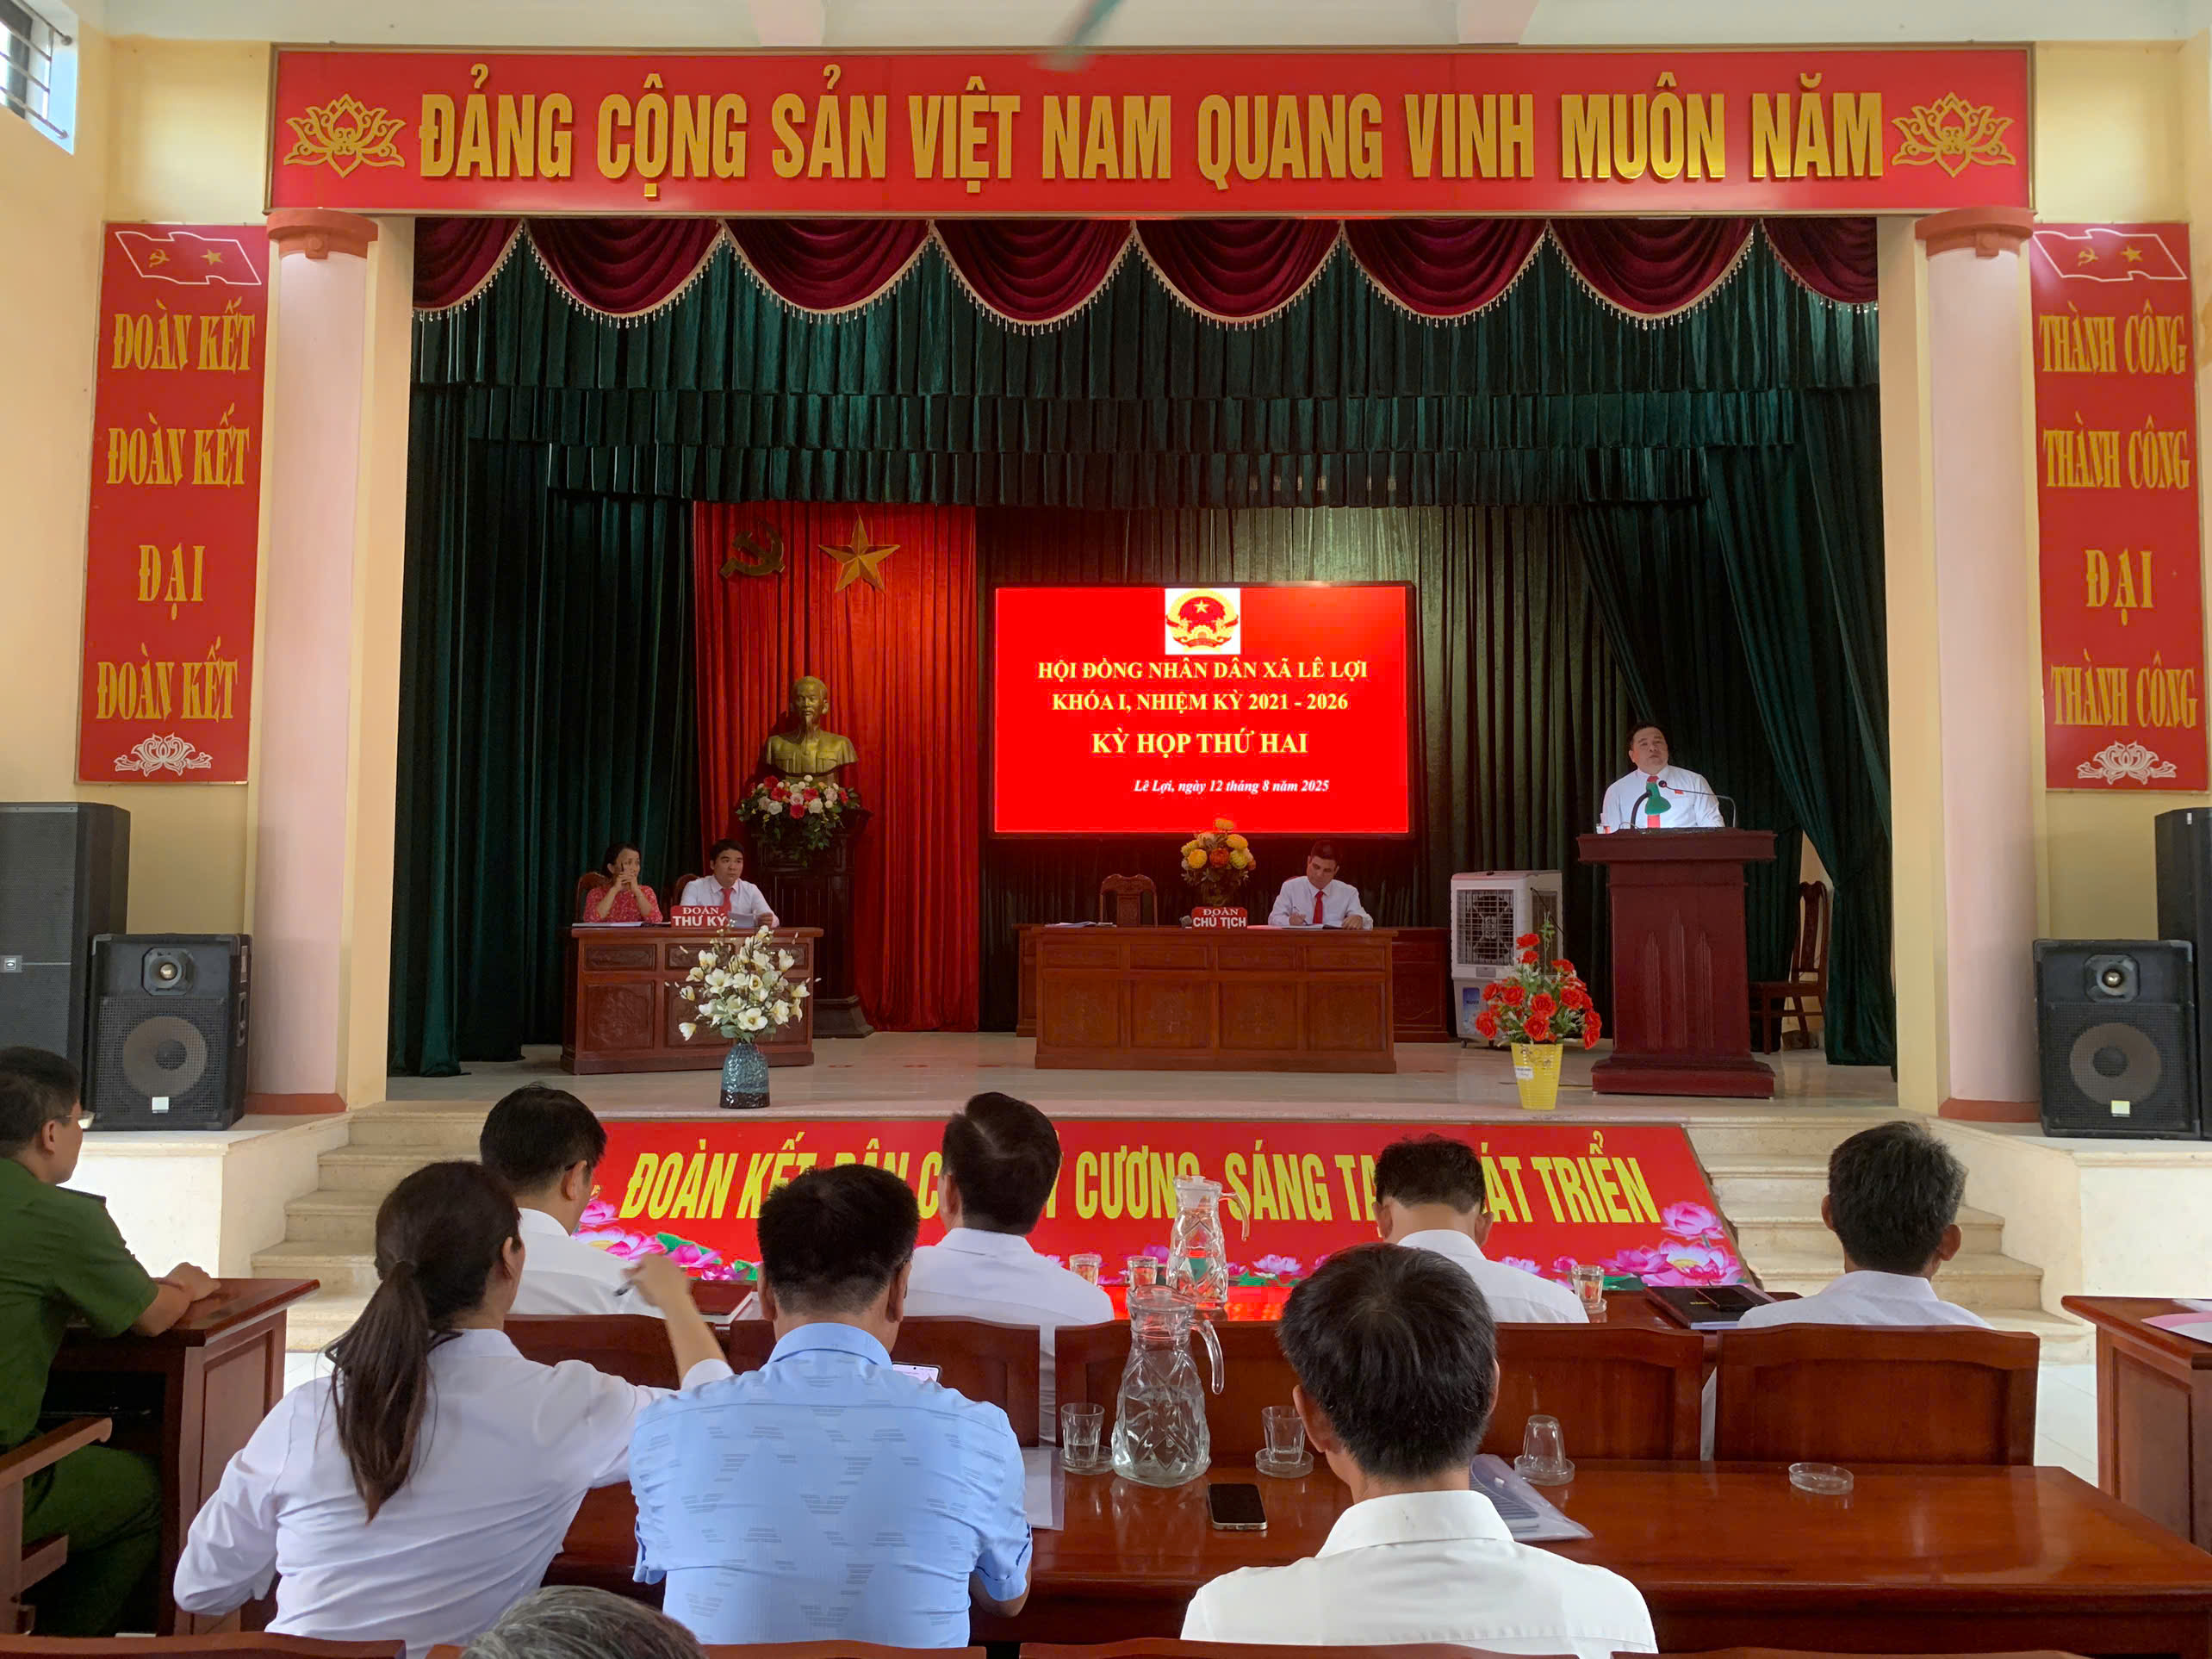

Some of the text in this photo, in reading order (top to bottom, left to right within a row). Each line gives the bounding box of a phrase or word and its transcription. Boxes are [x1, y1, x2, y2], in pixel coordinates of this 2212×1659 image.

[419, 64, 1884, 197] ĐẢNG CỘNG SẢN VIỆT NAM QUANG VINH MUÔN NĂM
[111, 295, 256, 373] ĐOÀN KẾT
[2039, 299, 2187, 375] THÀNH CÔNG
[106, 402, 251, 488] ĐOÀN KẾT
[2042, 411, 2190, 490] THÀNH CÔNG
[137, 543, 206, 621] ĐẠI
[2085, 548, 2153, 626] ĐẠI
[96, 636, 239, 724] ĐOÀN KẾT
[1038, 656, 1368, 683] HỘI ĐỒNG NHÂN DÂN XÃ LÊ LỢI
[1053, 689, 1114, 711] KHÓA
[1118, 693, 1132, 714] I,
[1136, 690, 1208, 714] NHIỆM
[1212, 689, 1244, 711] KỲ
[1248, 693, 1289, 711] 2021
[1307, 693, 1349, 711] 2026
[2050, 648, 2198, 729] THÀNH CÔNG
[1092, 726, 1309, 759] KỲ HỌP THỨ HAI
[1134, 780, 1150, 792] Lê
[1177, 780, 1206, 795] ngày
[1209, 780, 1223, 792] 12
[1226, 780, 1260, 795] tháng
[1262, 780, 1270, 792] 8
[1272, 780, 1298, 792] năm
[1301, 780, 1329, 792] 2025
[672, 913, 727, 927] THƯ KÝ
[1193, 915, 1246, 929] CHỦ TỊCH
[1203, 907, 1239, 916] ĐOÀN
[618, 1139, 739, 1220] ĐOÀN
[1225, 1139, 1333, 1221] SÁNG
[1530, 1130, 1662, 1223] TRIỂN
